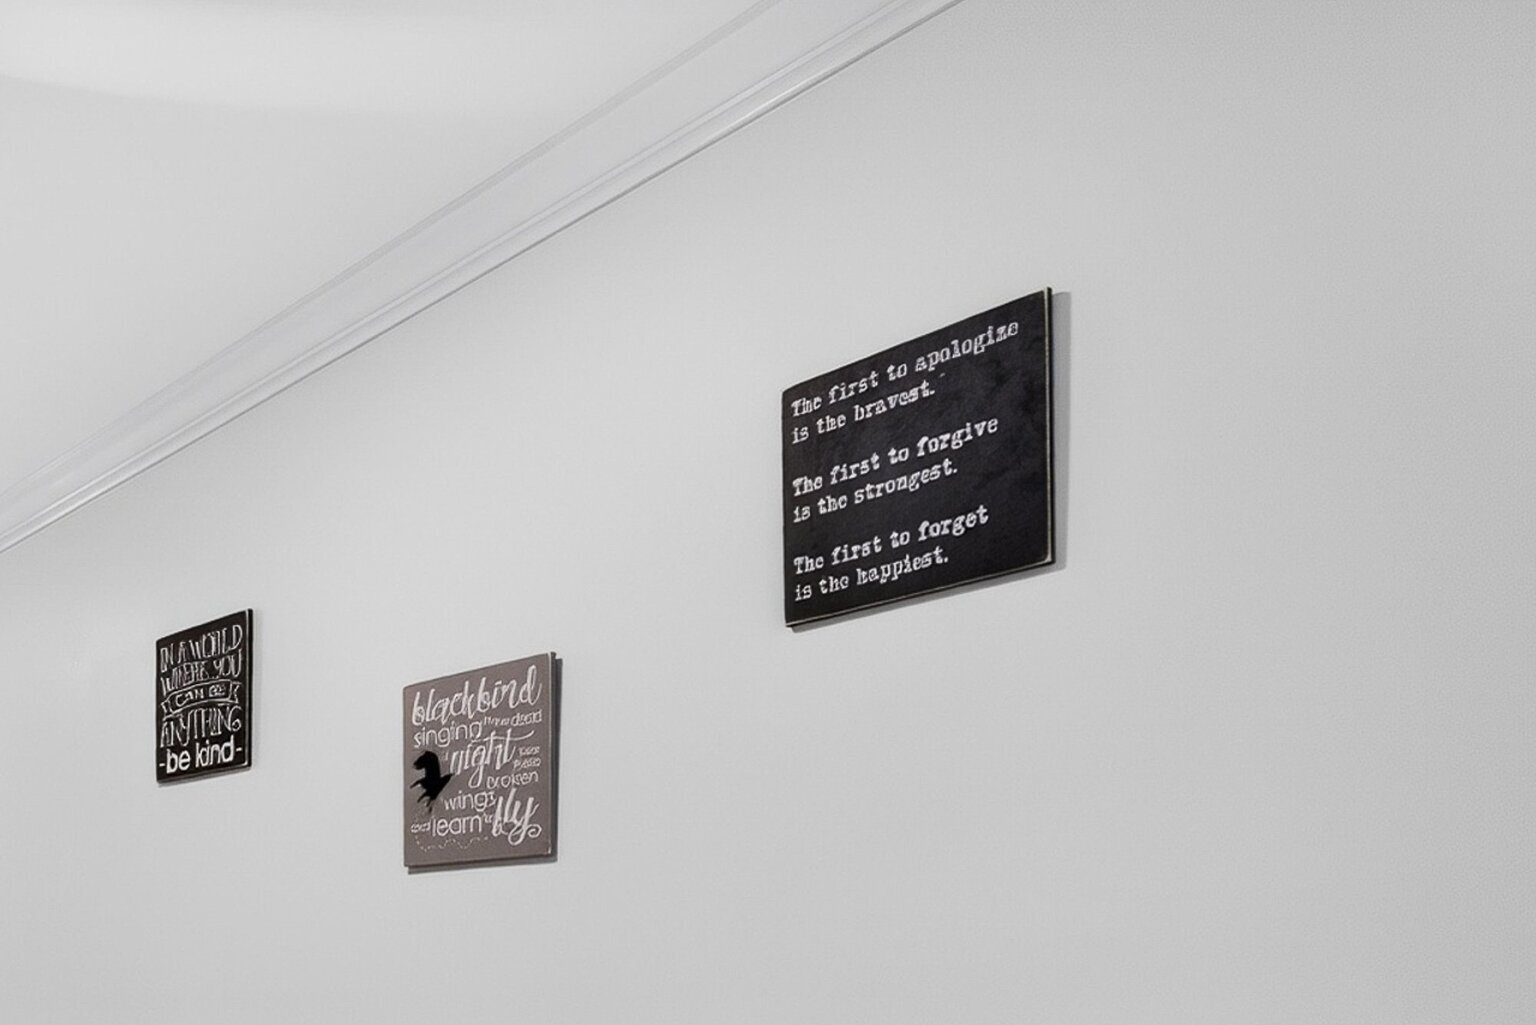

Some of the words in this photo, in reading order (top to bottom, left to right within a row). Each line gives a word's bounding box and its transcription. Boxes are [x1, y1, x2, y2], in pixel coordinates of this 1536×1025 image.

[791, 397, 822, 418] The
[828, 372, 879, 405] first
[886, 362, 908, 383] to
[914, 320, 1019, 373] apologize
[791, 428, 809, 445] is
[816, 412, 847, 435] the
[854, 379, 936, 423] bravest.
[792, 476, 823, 497] The
[830, 452, 880, 485] first
[887, 445, 909, 465] to
[916, 417, 998, 457] forgive
[793, 506, 810, 523] is
[817, 491, 848, 515] the
[854, 457, 958, 505] strongest.
[793, 555, 824, 575] The
[831, 535, 882, 565] first
[890, 530, 910, 548] to
[917, 504, 989, 541] forget
[794, 584, 812, 601] is
[819, 572, 849, 594] the
[856, 545, 949, 586] happiest.
[188, 624, 243, 660] WORLD
[160, 660, 210, 696] WHERE
[213, 648, 242, 679] YOU
[175, 688, 205, 707] CAN
[160, 702, 243, 748] ANYTHING
[413, 720, 483, 748] singing
[449, 728, 535, 789] night
[431, 815, 482, 837] learn
[492, 787, 543, 846] fly
[441, 790, 497, 812] wings
